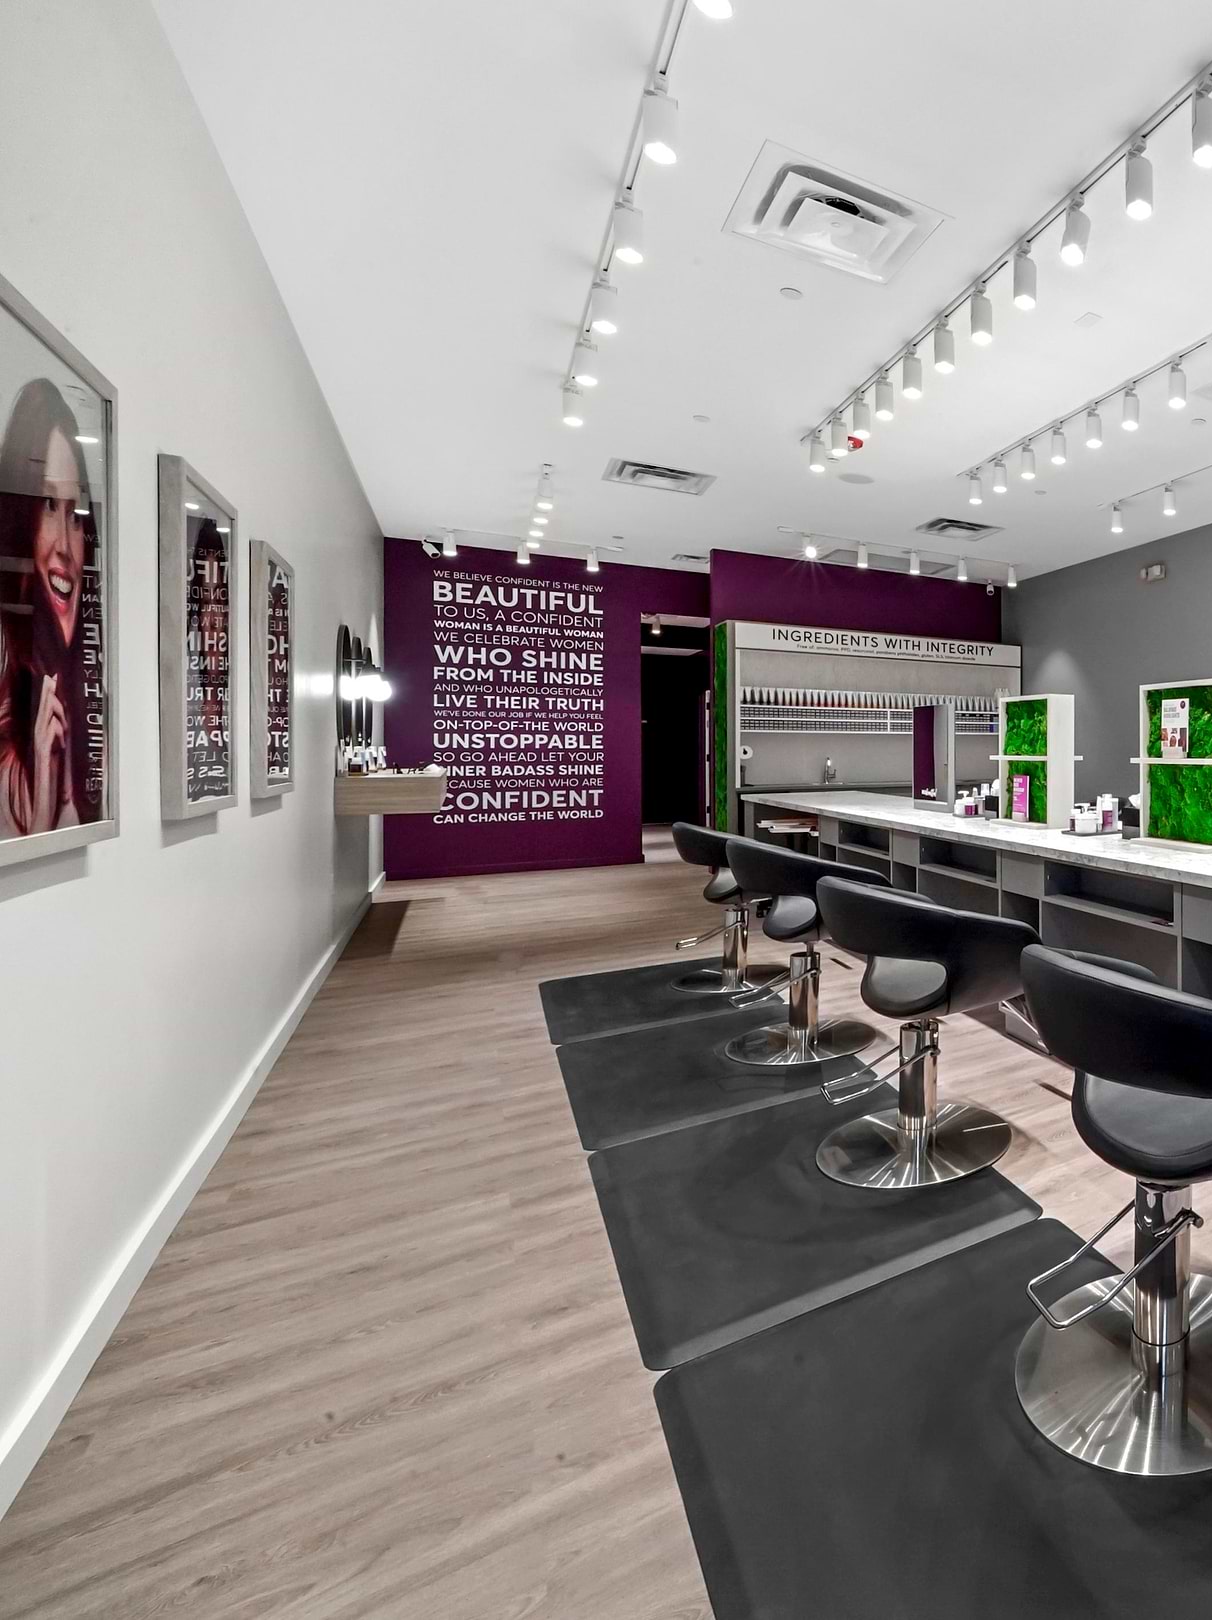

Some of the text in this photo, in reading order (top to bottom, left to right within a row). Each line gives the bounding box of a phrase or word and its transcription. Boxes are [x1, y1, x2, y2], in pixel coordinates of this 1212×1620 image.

[434, 570, 450, 578] WE
[454, 572, 492, 582] BELIEVE
[495, 576, 550, 587] CONFIDENT
[433, 581, 603, 614] BEAUTIFUL
[434, 604, 603, 628] TO US, A CONFIDENT
[434, 620, 603, 638] WOMAN IS A BEAUTIFUL WOMAN
[434, 631, 604, 651] WE CELEBRATE WOMEN
[772, 629, 994, 656] INGREDIENTS WITH INTEGRITY
[434, 644, 604, 671] WHO SHINE
[433, 666, 604, 686] FROM THE INSIDE
[434, 683, 603, 696] AND WHO UNAPOLOGETICALLY
[433, 694, 604, 711] LIVE THEIR TRUTH
[433, 719, 604, 732] ON-TOP-OF-THE WORLD
[433, 733, 604, 749] UNSTOPPABLE
[433, 752, 604, 762] SO GO AHEAD LET YOUR
[447, 764, 604, 776] NER BADASS SHINE
[447, 778, 603, 789] CAUSE WOMEN WHO ARE
[433, 810, 603, 824] CAN CHANGE THE WORLD
